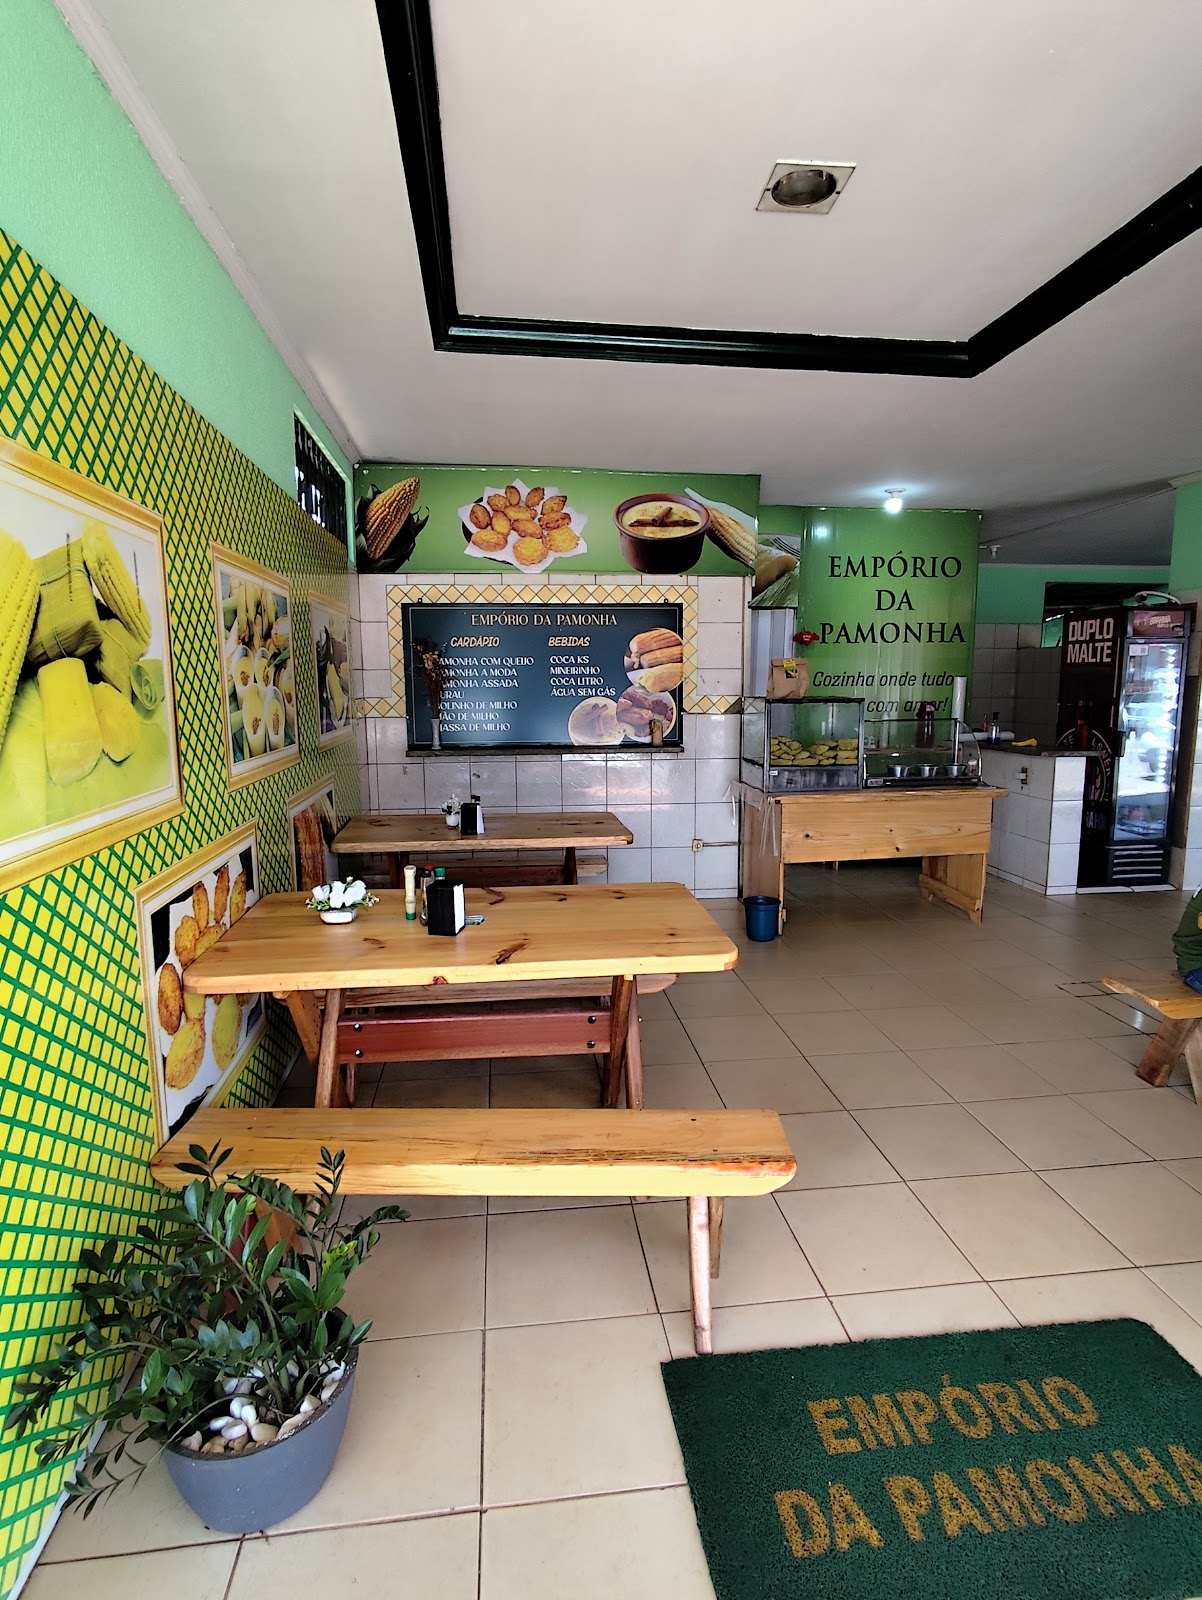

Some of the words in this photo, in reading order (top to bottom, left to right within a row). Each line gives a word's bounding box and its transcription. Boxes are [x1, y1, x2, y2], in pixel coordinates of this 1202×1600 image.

[828, 550, 962, 578] EMPÓRIO
[875, 589, 916, 611] DA
[471, 611, 529, 626] EMPÓRIO
[533, 614, 552, 626] DA
[557, 614, 618, 626] PAMONHA
[819, 622, 968, 644] PAMONHA
[1068, 617, 1115, 642] DUPLO
[450, 635, 500, 647] CARDÁPIO
[548, 636, 591, 647] BEBIDAS
[1067, 641, 1113, 664] MALTE
[438, 657, 479, 667] AMONHA
[480, 657, 501, 667] COM
[502, 657, 535, 668] QUEIJO
[549, 655, 576, 665] COCA
[577, 655, 590, 664] KS
[481, 668, 489, 677] A
[489, 668, 518, 677] MODA
[549, 666, 601, 675] MINEIRINHO
[480, 679, 519, 688] ASSADA
[550, 677, 576, 686] COCA
[577, 677, 604, 686] LITRO
[812, 671, 876, 687] Cozinha
[879, 671, 917, 687] onde
[921, 672, 955, 687] tudo
[439, 691, 465, 699] URAU
[550, 686, 576, 697] ÁGUA
[577, 687, 596, 697] SEM
[597, 685, 617, 696] GÁS
[437, 701, 474, 710] OLINHO
[475, 701, 488, 710] DE
[489, 701, 518, 710] MILHO
[866, 700, 899, 713] com
[457, 712, 469, 720] DE
[471, 712, 500, 720] MILHO
[468, 723, 480, 732] DE
[482, 723, 511, 732] MILHO
[806, 1374, 1099, 1455] EMPÓRIO
[773, 1483, 885, 1559] DA
[883, 1444, 1202, 1543] PAMONHA
